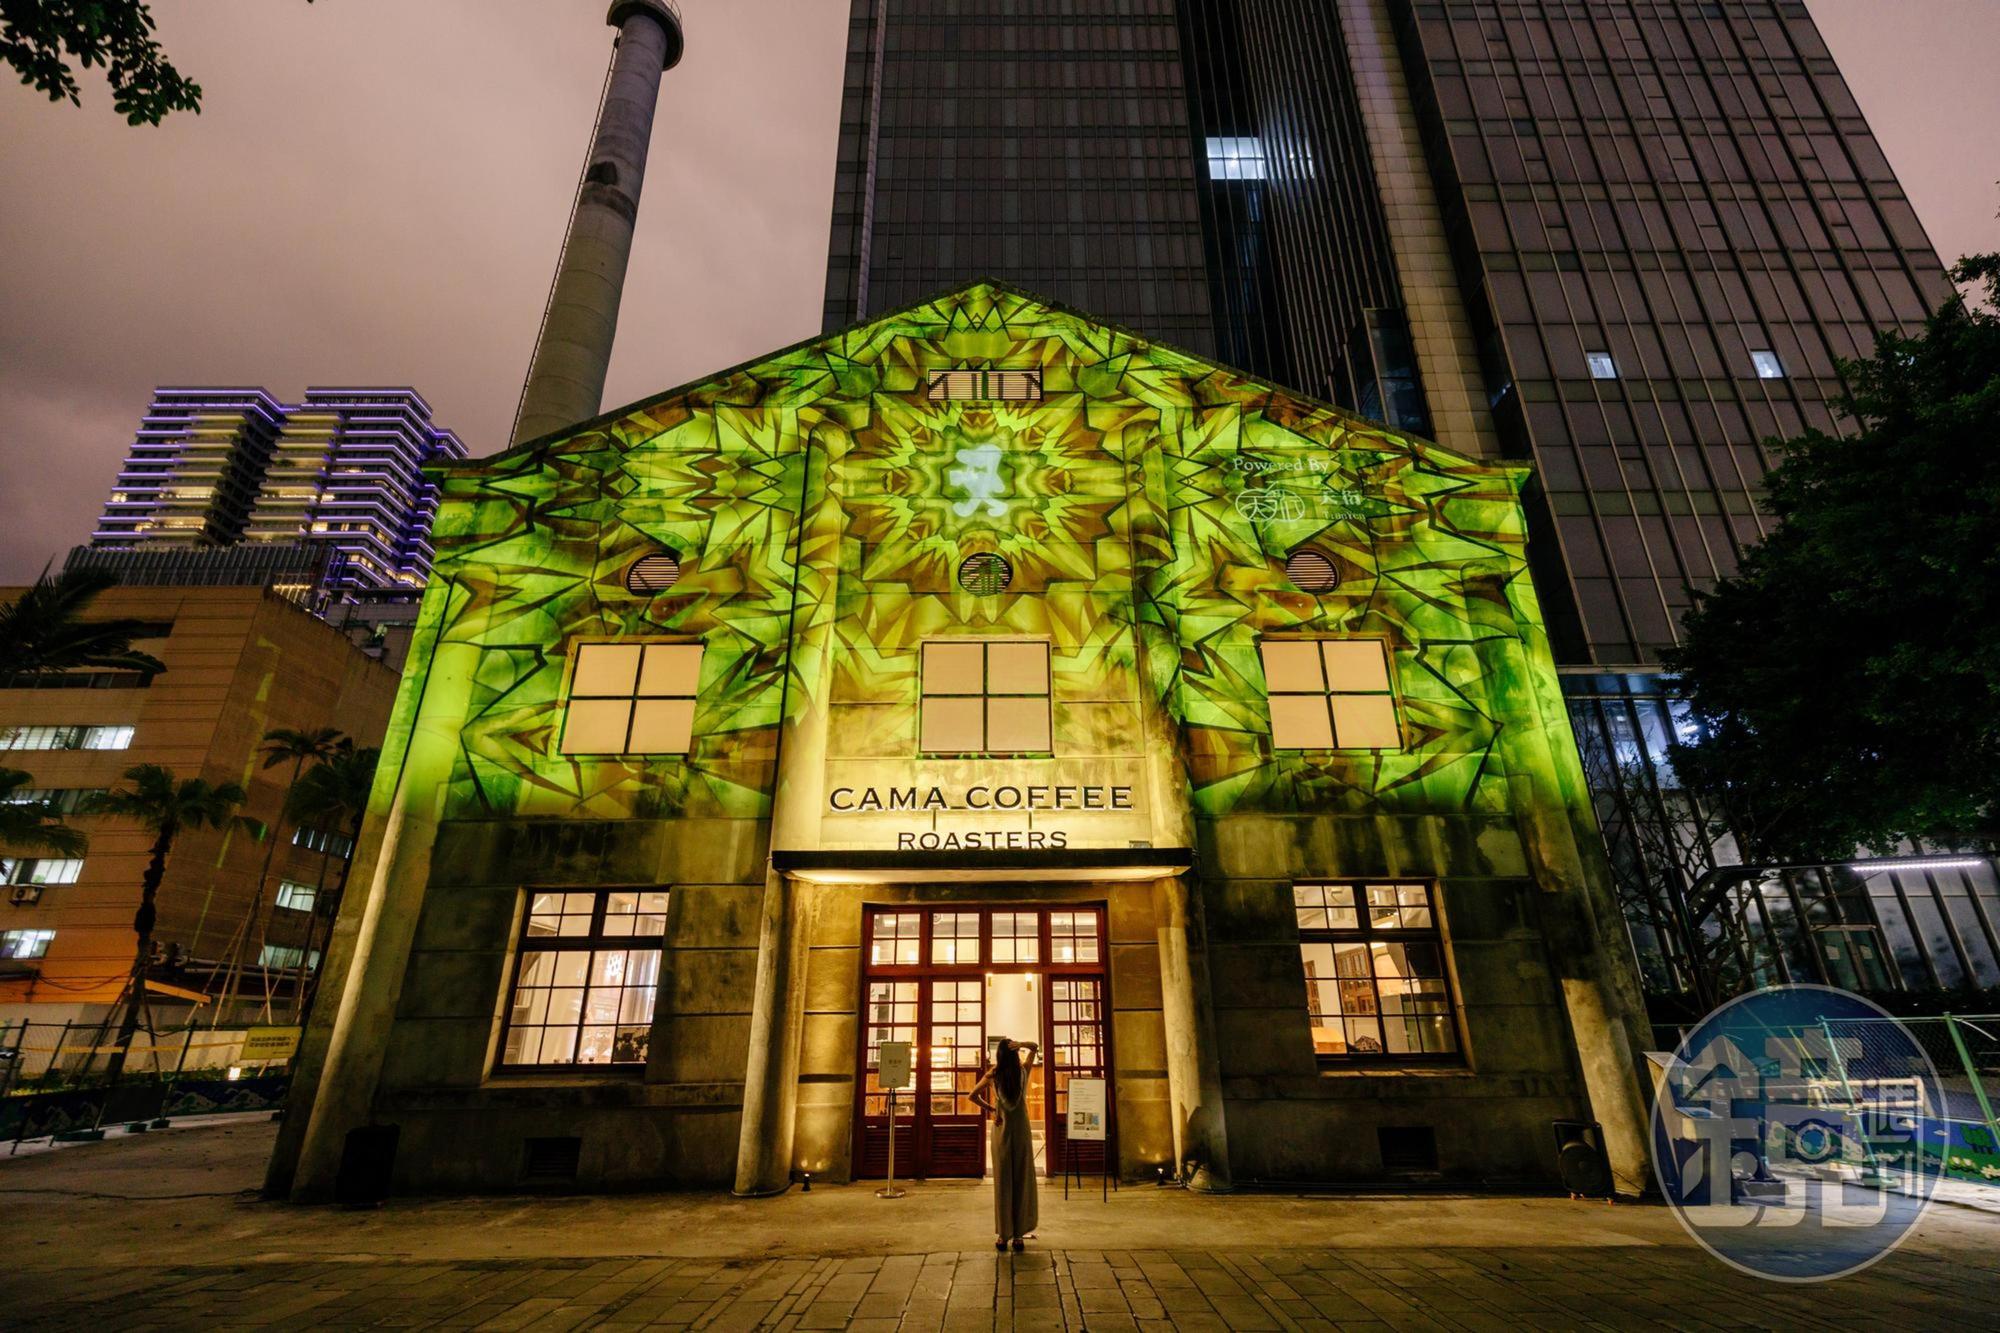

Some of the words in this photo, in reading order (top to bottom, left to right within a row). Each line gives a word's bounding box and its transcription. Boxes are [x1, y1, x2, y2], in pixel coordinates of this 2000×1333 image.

[1233, 457, 1303, 472] Powered
[1308, 458, 1330, 473] By
[829, 786, 948, 811] CAMA
[965, 785, 1134, 811] COFFEE
[897, 830, 1068, 851] ROASTERS
